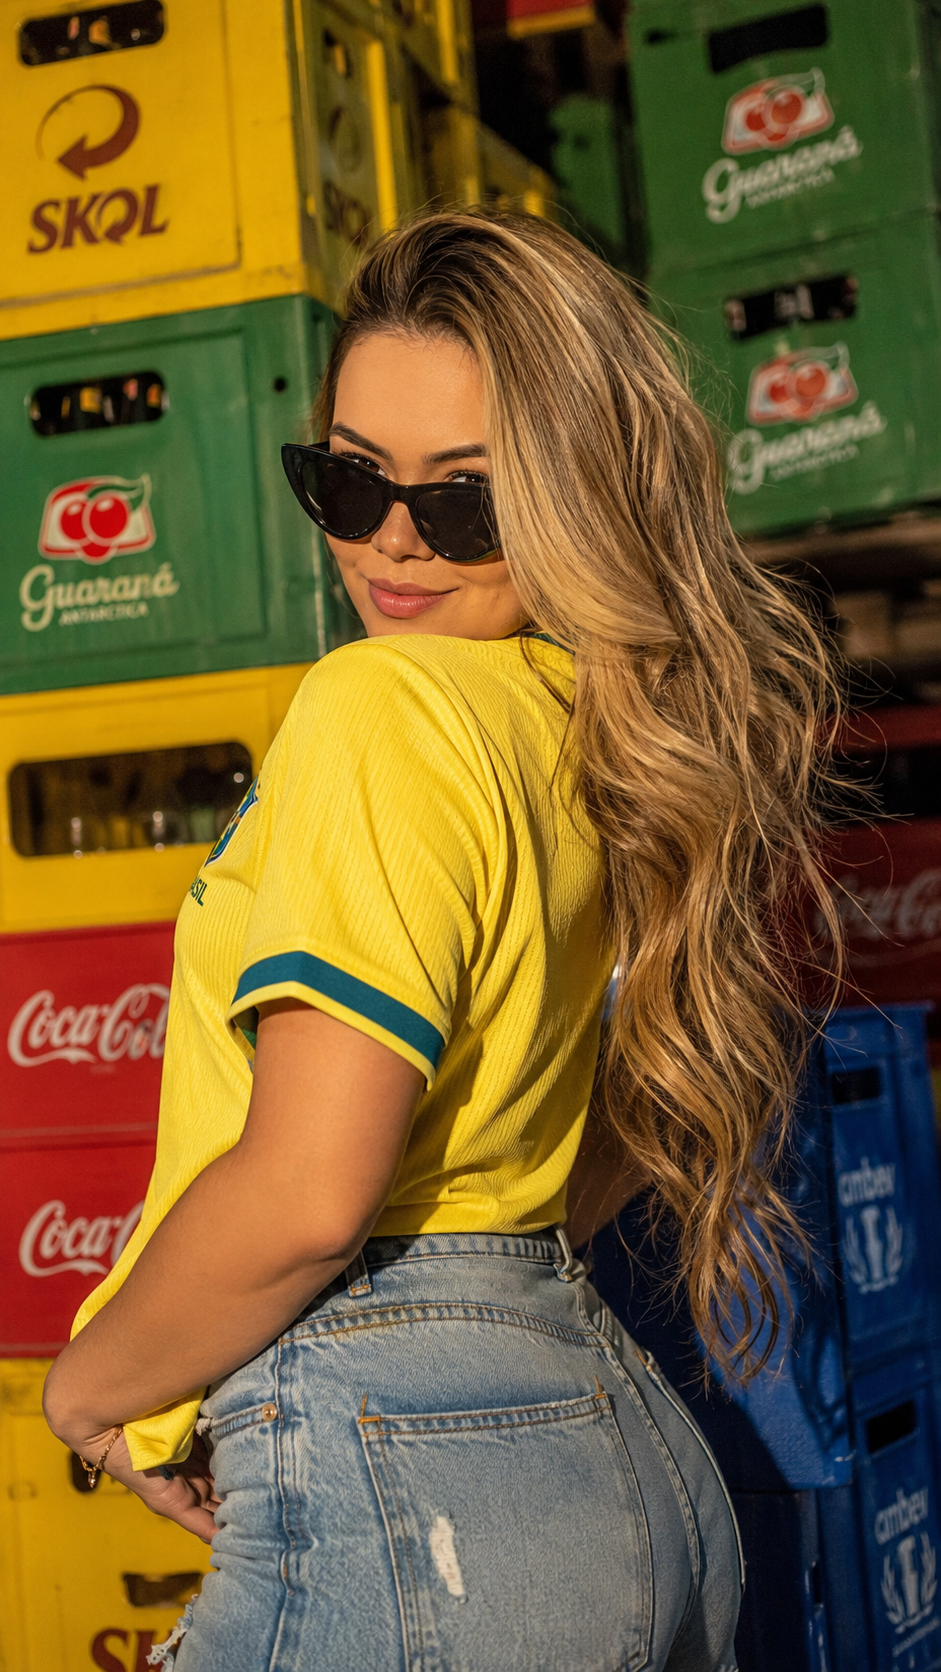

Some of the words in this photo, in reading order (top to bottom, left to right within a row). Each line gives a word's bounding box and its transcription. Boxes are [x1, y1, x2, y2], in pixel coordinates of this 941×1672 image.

[702, 124, 864, 224] Guaraná
[27, 183, 171, 255] SKOL
[19, 562, 180, 632] Guaraná
